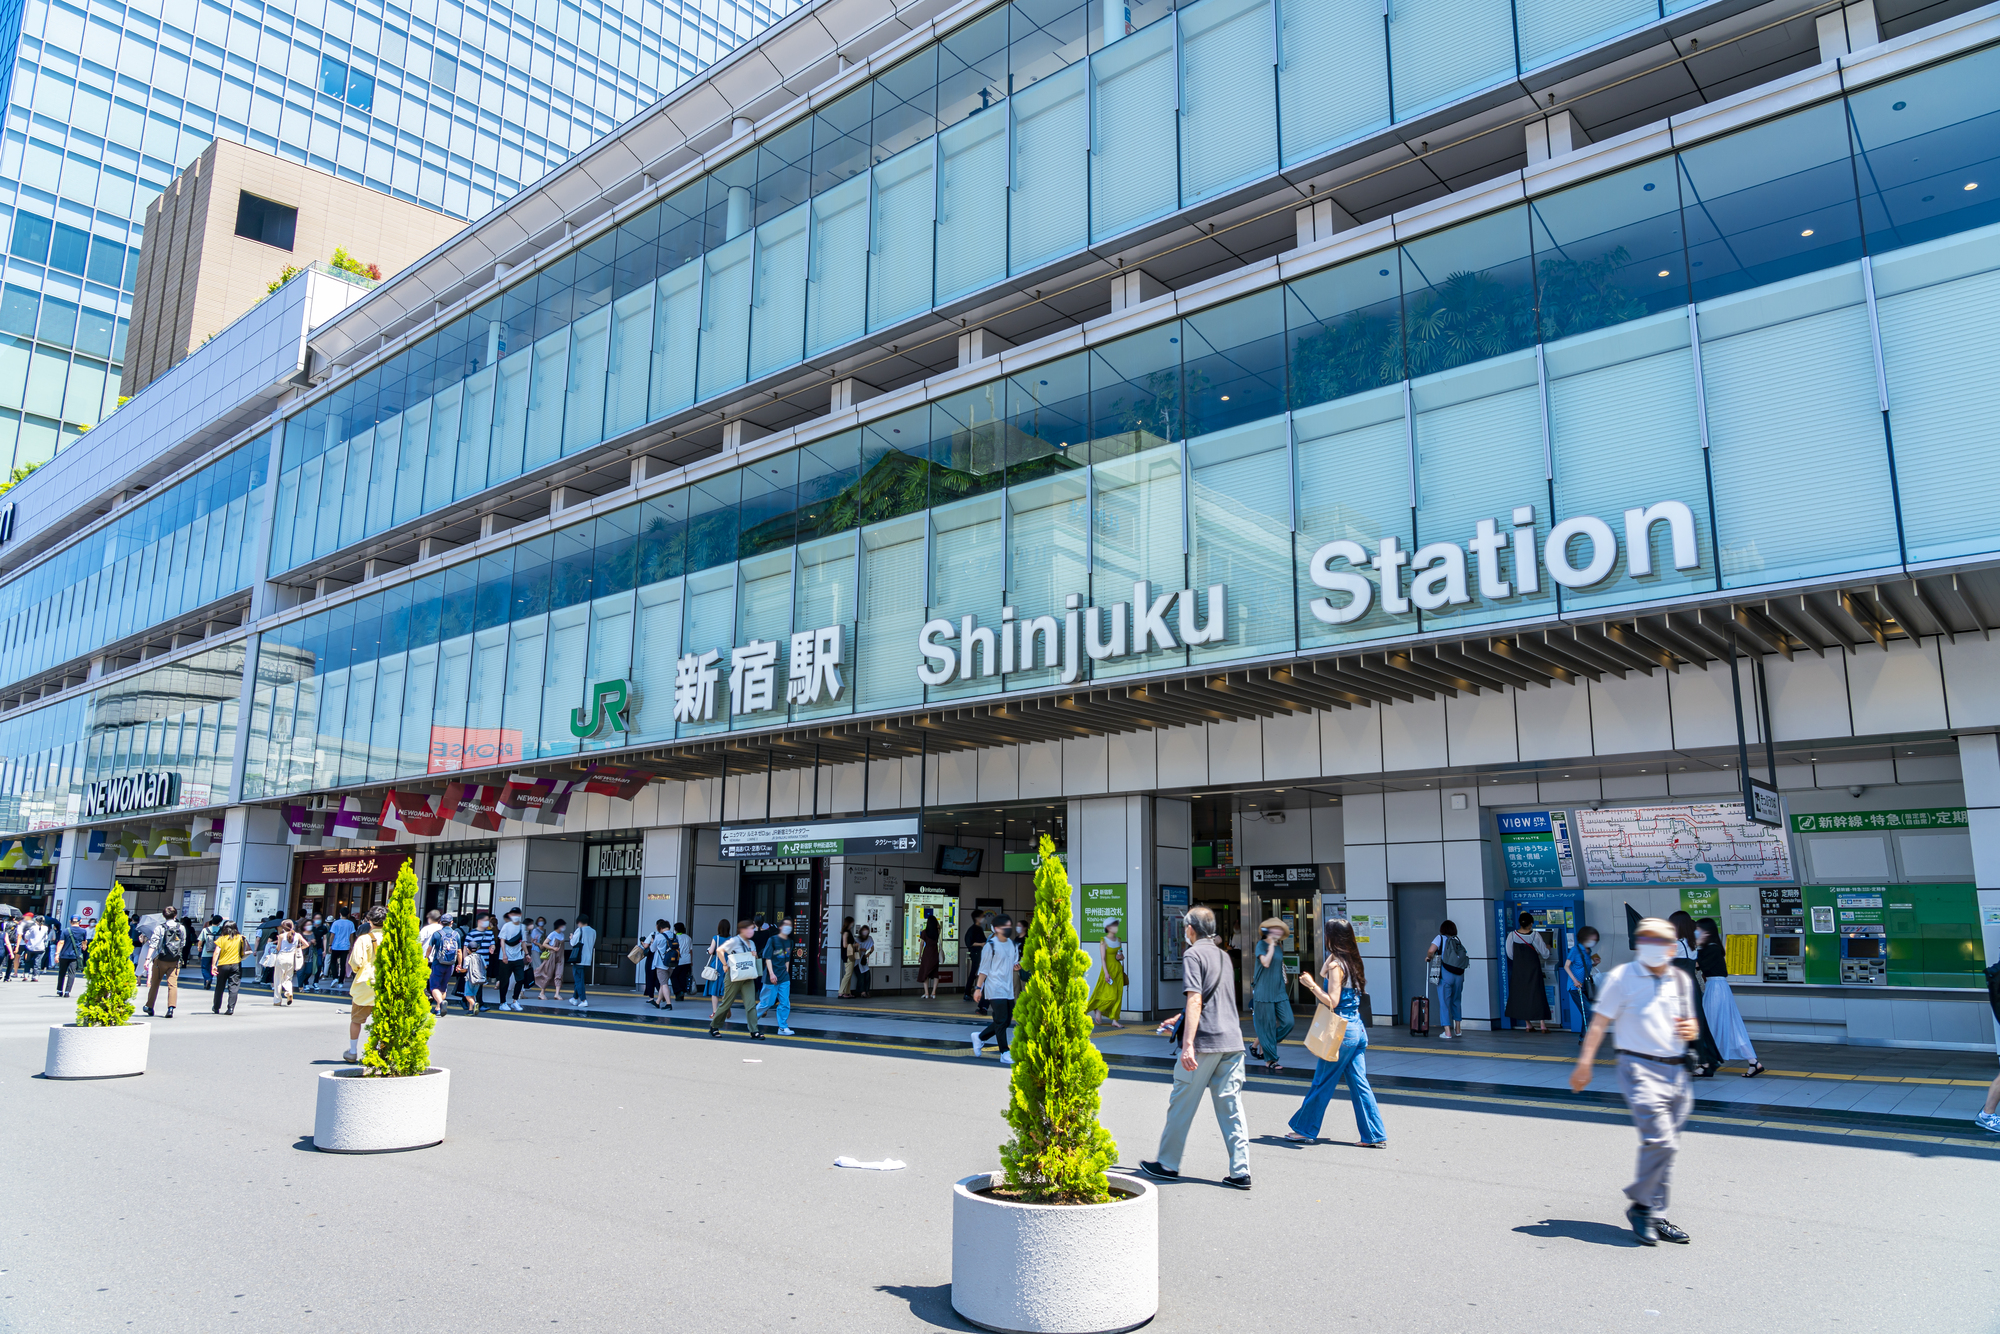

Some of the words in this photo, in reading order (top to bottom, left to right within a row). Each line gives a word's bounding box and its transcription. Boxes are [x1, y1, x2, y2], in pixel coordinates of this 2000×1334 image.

[917, 579, 1229, 685] Shinjuku
[1308, 500, 1702, 625] Station
[672, 624, 846, 723] 新宿駅
[570, 678, 632, 739] JR
[790, 843, 800, 851] JR
[453, 857, 496, 877] DEGREES
[1512, 868, 1556, 876] キャッシュカード
[1088, 889, 1099, 897] JR
[1687, 890, 1711, 899] きっぷ
[1761, 889, 1779, 898] きっぷ
[1781, 889, 1800, 898] 定期券
[1084, 907, 1124, 917] 甲州街道改札
